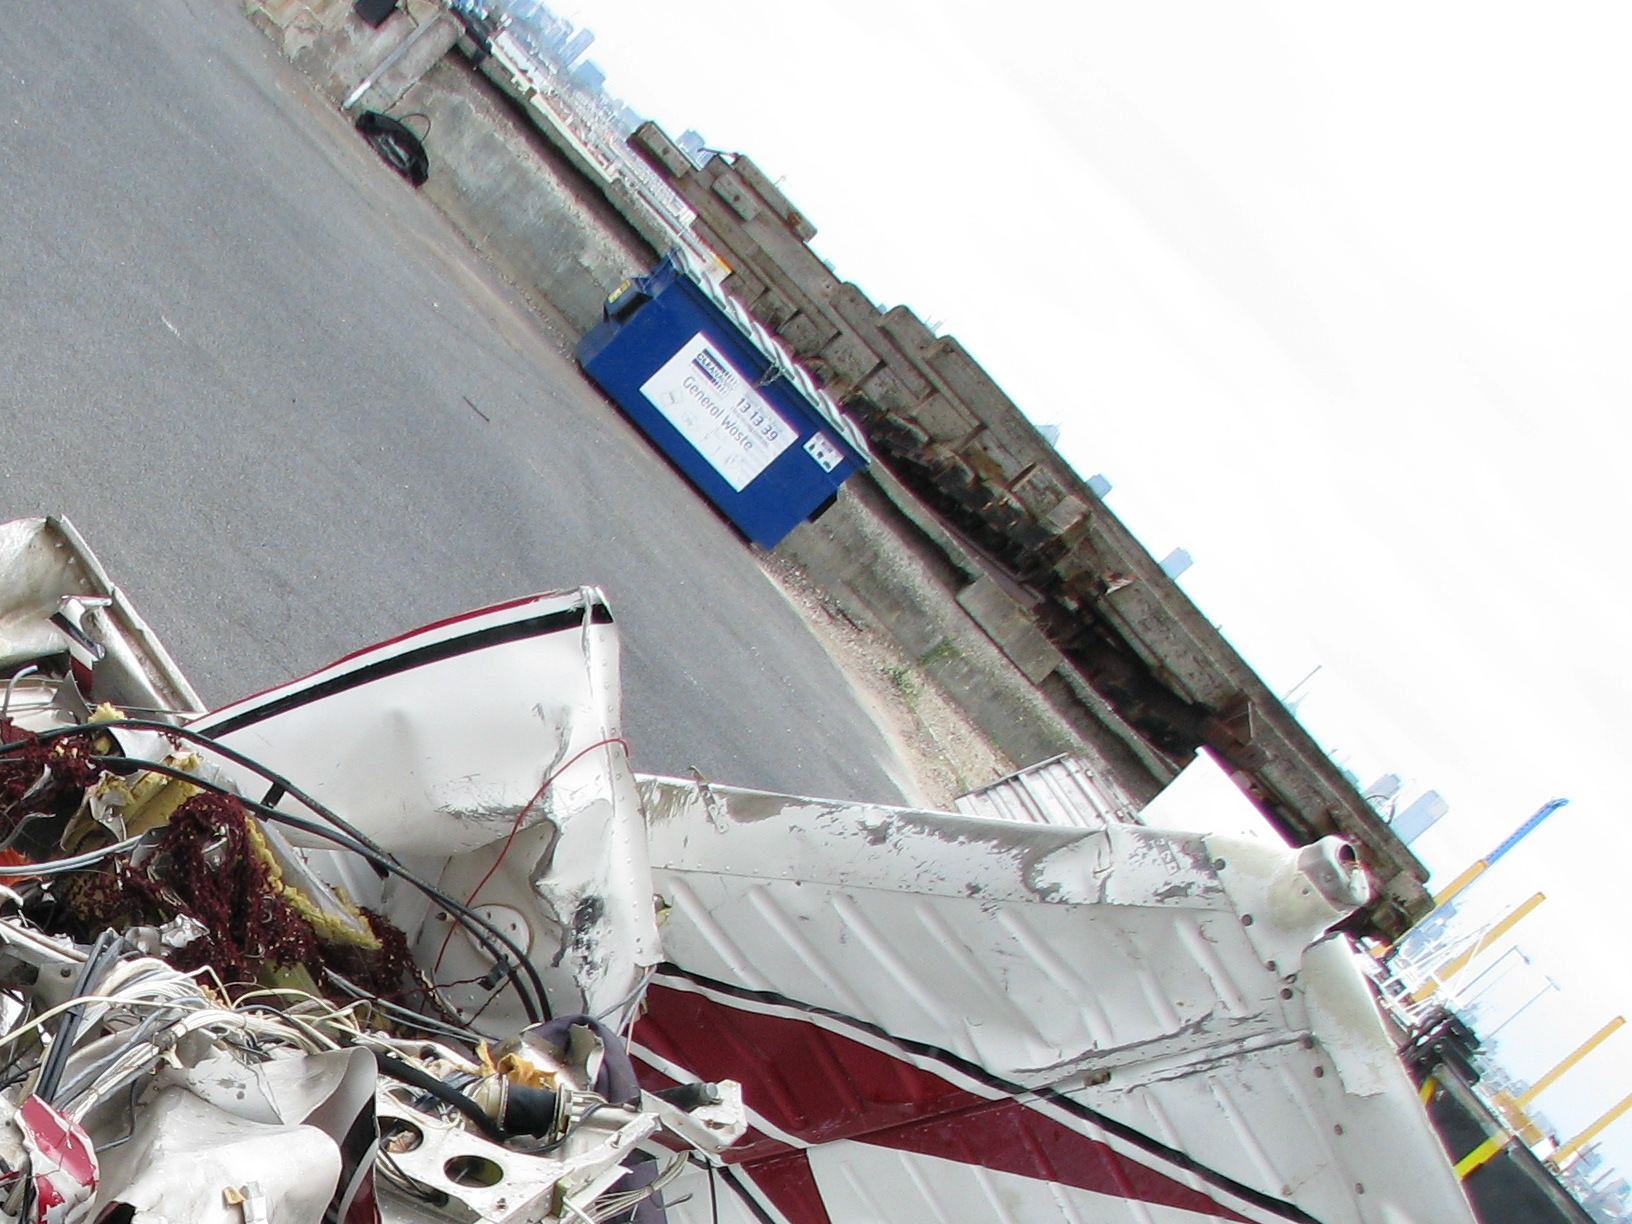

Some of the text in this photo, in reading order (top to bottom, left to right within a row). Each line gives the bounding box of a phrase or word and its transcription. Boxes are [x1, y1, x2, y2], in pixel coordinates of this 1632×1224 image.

[682, 376, 725, 419] General
[720, 414, 753, 451] Waste
[735, 398, 752, 413] 13
[749, 411, 765, 427] 13
[761, 425, 779, 442] 39
